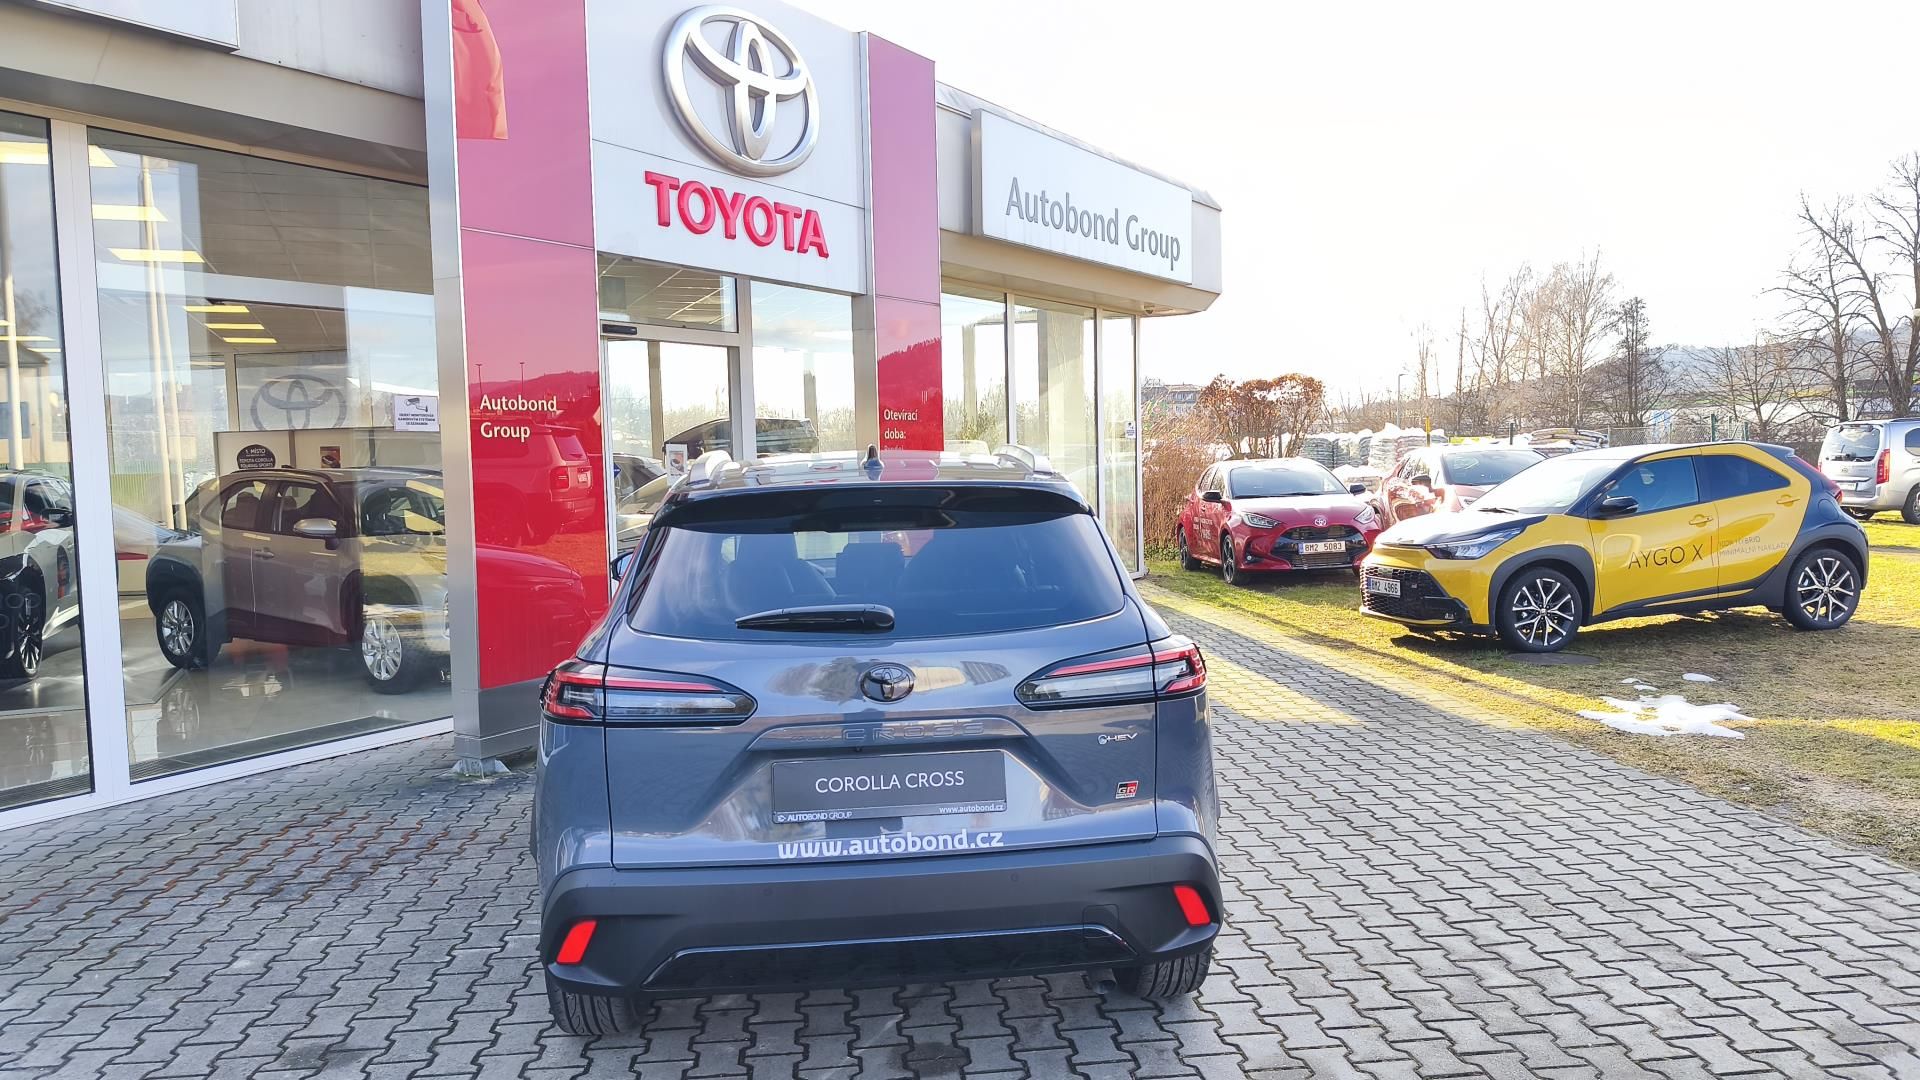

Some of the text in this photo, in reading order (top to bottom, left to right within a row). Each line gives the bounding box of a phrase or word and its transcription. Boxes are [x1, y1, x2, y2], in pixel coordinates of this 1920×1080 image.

[645, 171, 829, 258] TOYOTA
[1006, 176, 1181, 271] Autobond Group
[480, 394, 557, 412] Autobond
[884, 408, 918, 421] Otevírací
[480, 421, 531, 443] Group
[884, 427, 906, 439] doba:
[1628, 543, 1704, 570] AYGO X
[815, 770, 965, 794] COROLLA CROSS
[787, 811, 853, 822] AUTOBOND GROUP
[939, 803, 1005, 813] www.autobond.cz
[778, 829, 1004, 859] www.autobond.cz
